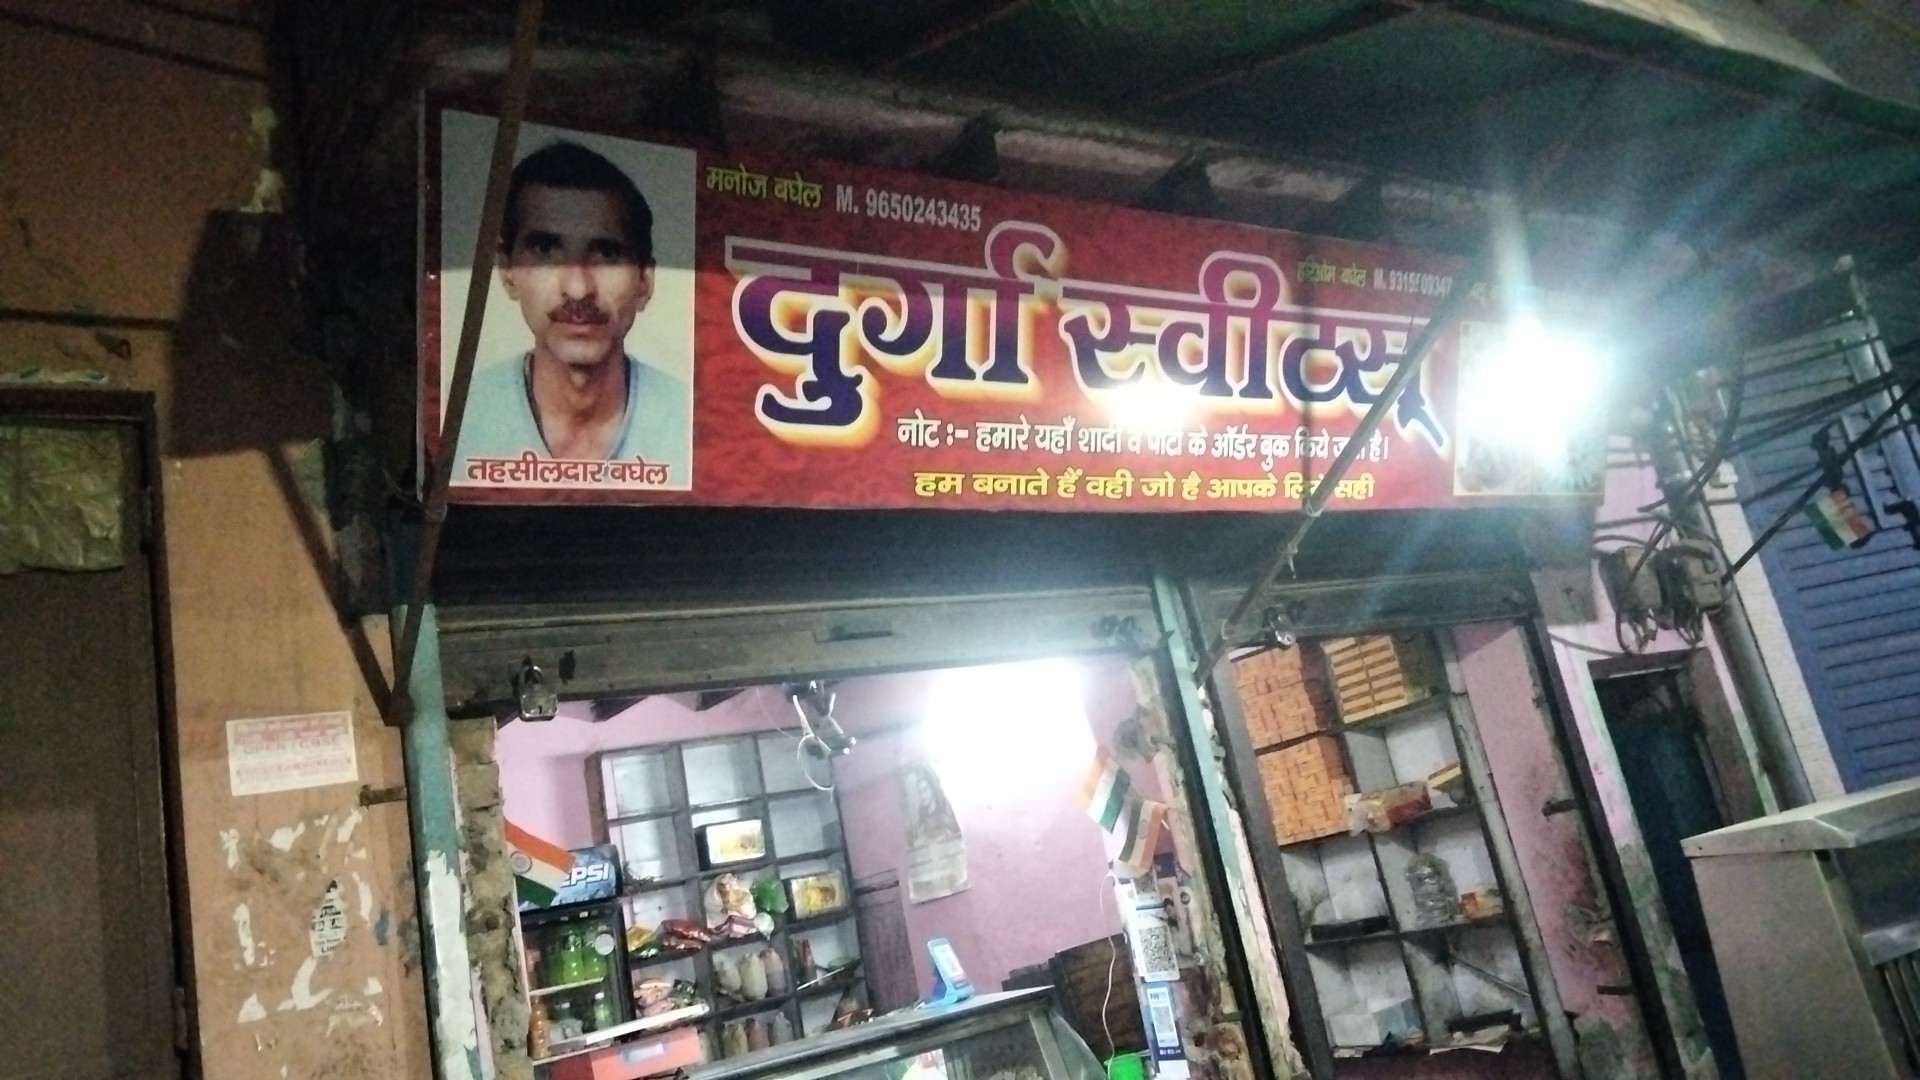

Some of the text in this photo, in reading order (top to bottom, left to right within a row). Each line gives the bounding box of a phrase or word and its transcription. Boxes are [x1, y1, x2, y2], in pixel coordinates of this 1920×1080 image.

[705, 163, 823, 209] मनोज बघेल
[836, 184, 981, 232] M. 9650243435
[1373, 268, 1387, 290] M.
[725, 222, 1068, 430] दुर्गा
[897, 408, 942, 448] नोट
[975, 413, 1031, 452] हमारे
[1034, 415, 1076, 454] यहाँ
[1188, 424, 1208, 456] के
[1211, 424, 1258, 460] ऑर्डर
[1260, 434, 1291, 471] बुक
[466, 450, 670, 484] तहसीलदार बघेल
[914, 472, 965, 497] हम
[972, 467, 1050, 496] बनाते
[1056, 467, 1084, 498] हैं
[1086, 468, 1135, 499] वही
[1140, 472, 1176, 498] जो
[1182, 470, 1202, 500] है
[1206, 472, 1277, 499] आपके
[1334, 472, 1376, 500] सही
